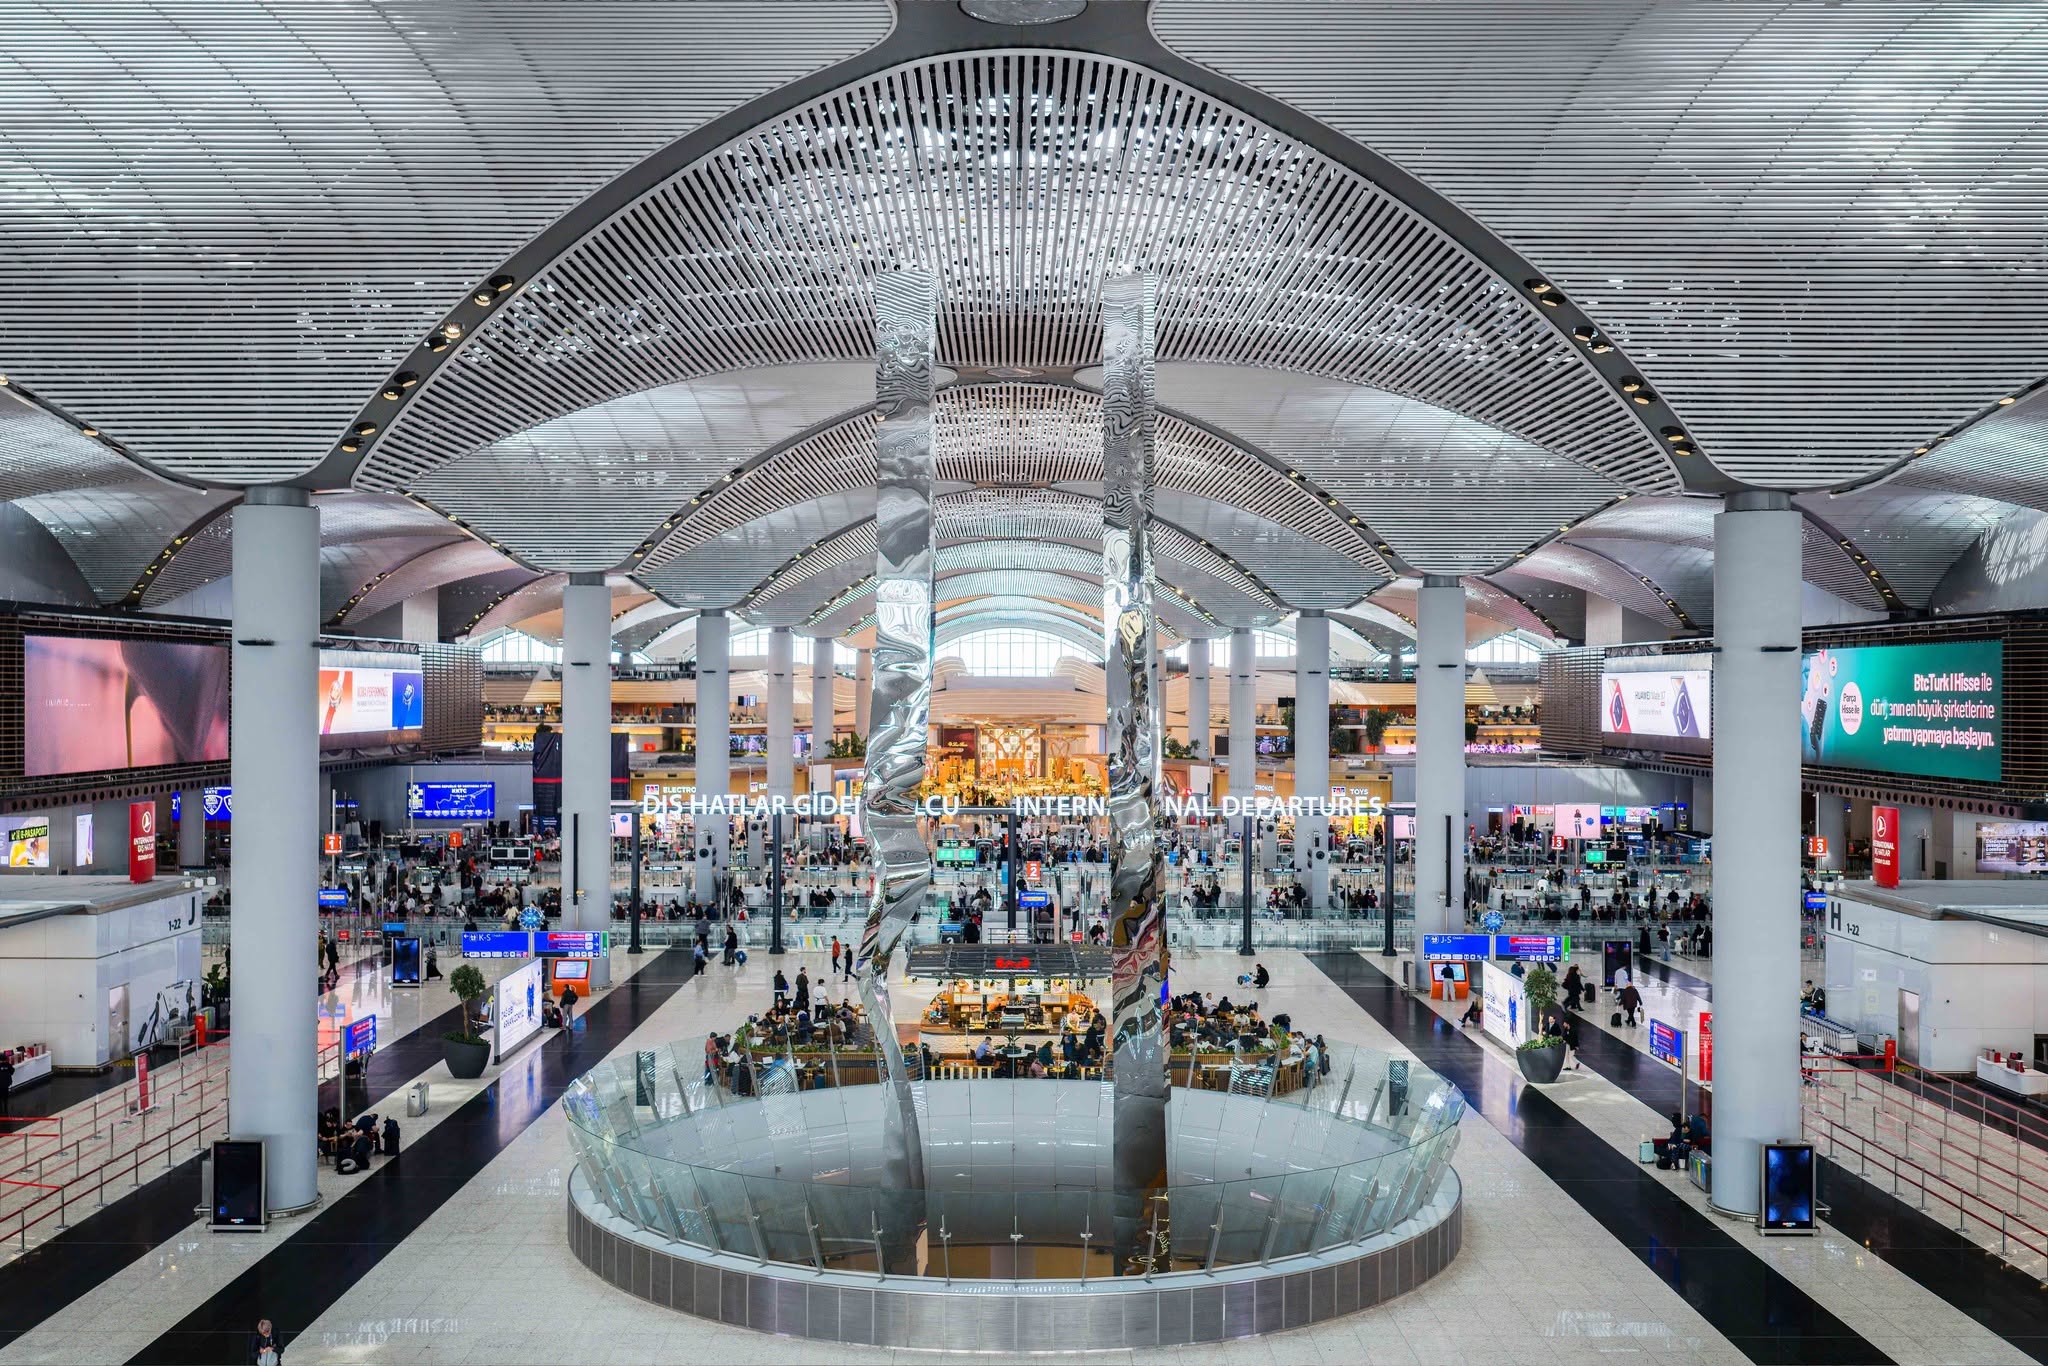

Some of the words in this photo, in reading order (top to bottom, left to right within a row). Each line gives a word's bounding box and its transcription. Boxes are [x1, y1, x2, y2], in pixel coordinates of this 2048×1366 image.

[1914, 672, 1950, 692] BtcTurk
[1954, 672, 1980, 692] Hisse
[1981, 672, 1993, 692] ile
[1843, 693, 1857, 704] Parça
[1842, 704, 1855, 714] Hisse
[1905, 703, 1917, 717] en
[1917, 699, 1942, 721] büyük
[1943, 699, 1995, 722] şirketlerine
[1883, 725, 1912, 745] yatırım
[1912, 728, 1953, 749] yapmaya
[1953, 726, 1995, 751] başlayın.
[1255, 784, 1274, 792] CTRONICS
[690, 794, 787, 815] HATLAR
[793, 790, 860, 815] GİDE
[914, 795, 959, 816] LCU
[1222, 795, 1382, 817] DEPARTURES
[329, 839, 335, 850] 1
[1556, 839, 1562, 847] 3
[1817, 842, 1824, 853] 3
[1030, 866, 1037, 877] 2
[188, 896, 195, 926] J
[1831, 901, 1841, 931] H
[169, 918, 181, 931] 1-22
[1847, 922, 1860, 936] 1-22
[1440, 936, 1452, 944] J-S
